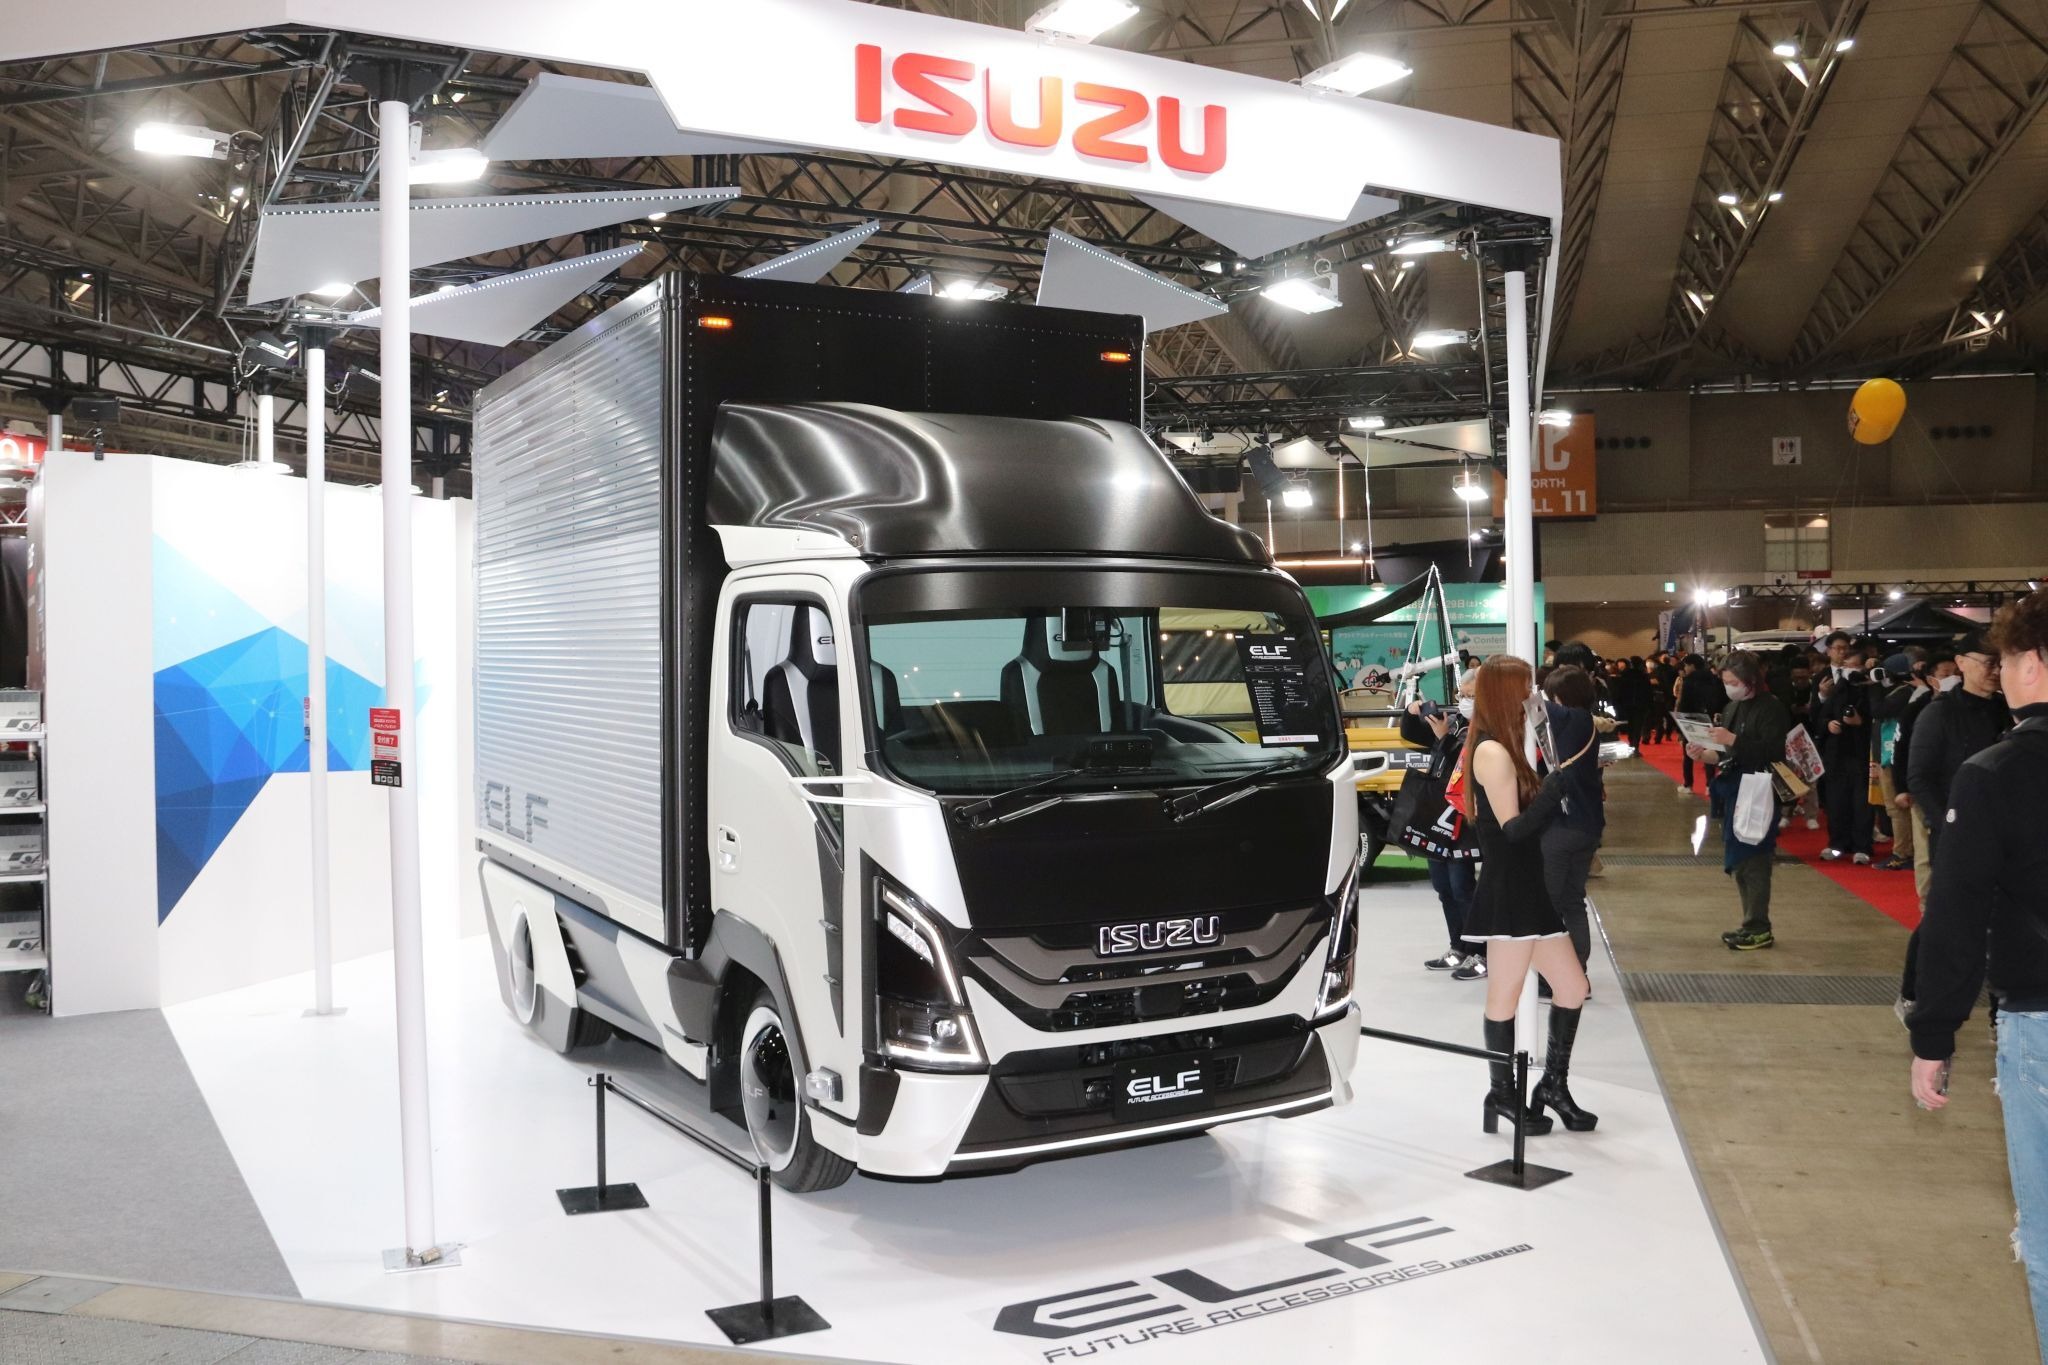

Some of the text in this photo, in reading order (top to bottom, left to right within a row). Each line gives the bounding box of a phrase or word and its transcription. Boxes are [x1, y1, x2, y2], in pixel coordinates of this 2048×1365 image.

[855, 43, 1227, 174] ISUZU
[1530, 478, 1566, 489] ORTH
[1531, 489, 1587, 513] LL 11
[1249, 645, 1288, 656] ELF
[1473, 636, 1506, 645] Conten
[1389, 752, 1432, 763] LFm
[484, 780, 549, 844] ELF
[1099, 915, 1220, 955] ISUZU
[1126, 1069, 1201, 1097] ELF
[993, 1216, 1456, 1339] ELF
[1043, 1243, 1535, 1365] FUTURE ACCESSORIES EDITION
